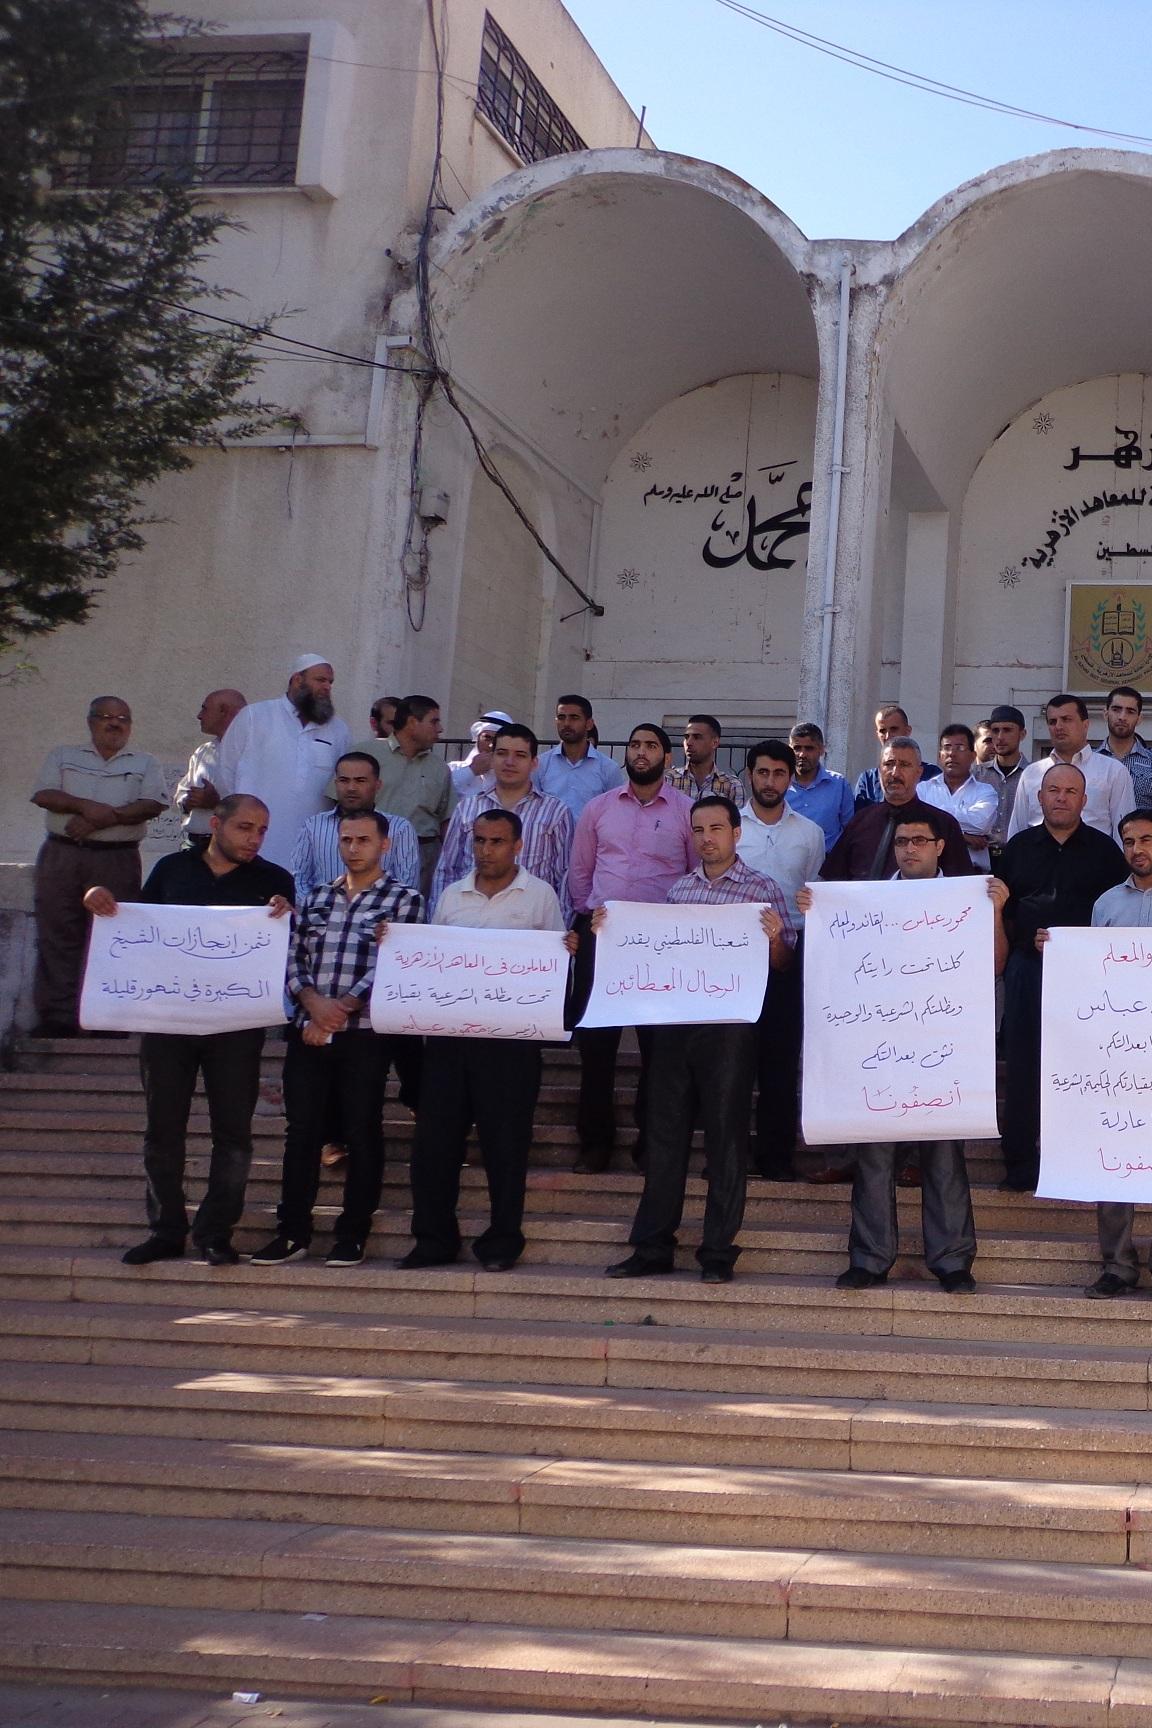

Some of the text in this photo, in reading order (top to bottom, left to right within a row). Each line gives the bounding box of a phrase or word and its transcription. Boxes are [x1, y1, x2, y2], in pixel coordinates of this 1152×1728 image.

[695, 484, 719, 503] الله
[902, 910, 945, 930] عباس
[109, 926, 160, 958] الشيخ
[616, 926, 749, 955] شعبنا الفلسطيني يقدر
[937, 951, 965, 973] كلنا
[102, 979, 138, 999] قليلة
[204, 979, 271, 1003] الكبيرة
[1076, 989, 1149, 1020] عباس
[1100, 1111, 1146, 1132] عادلة
